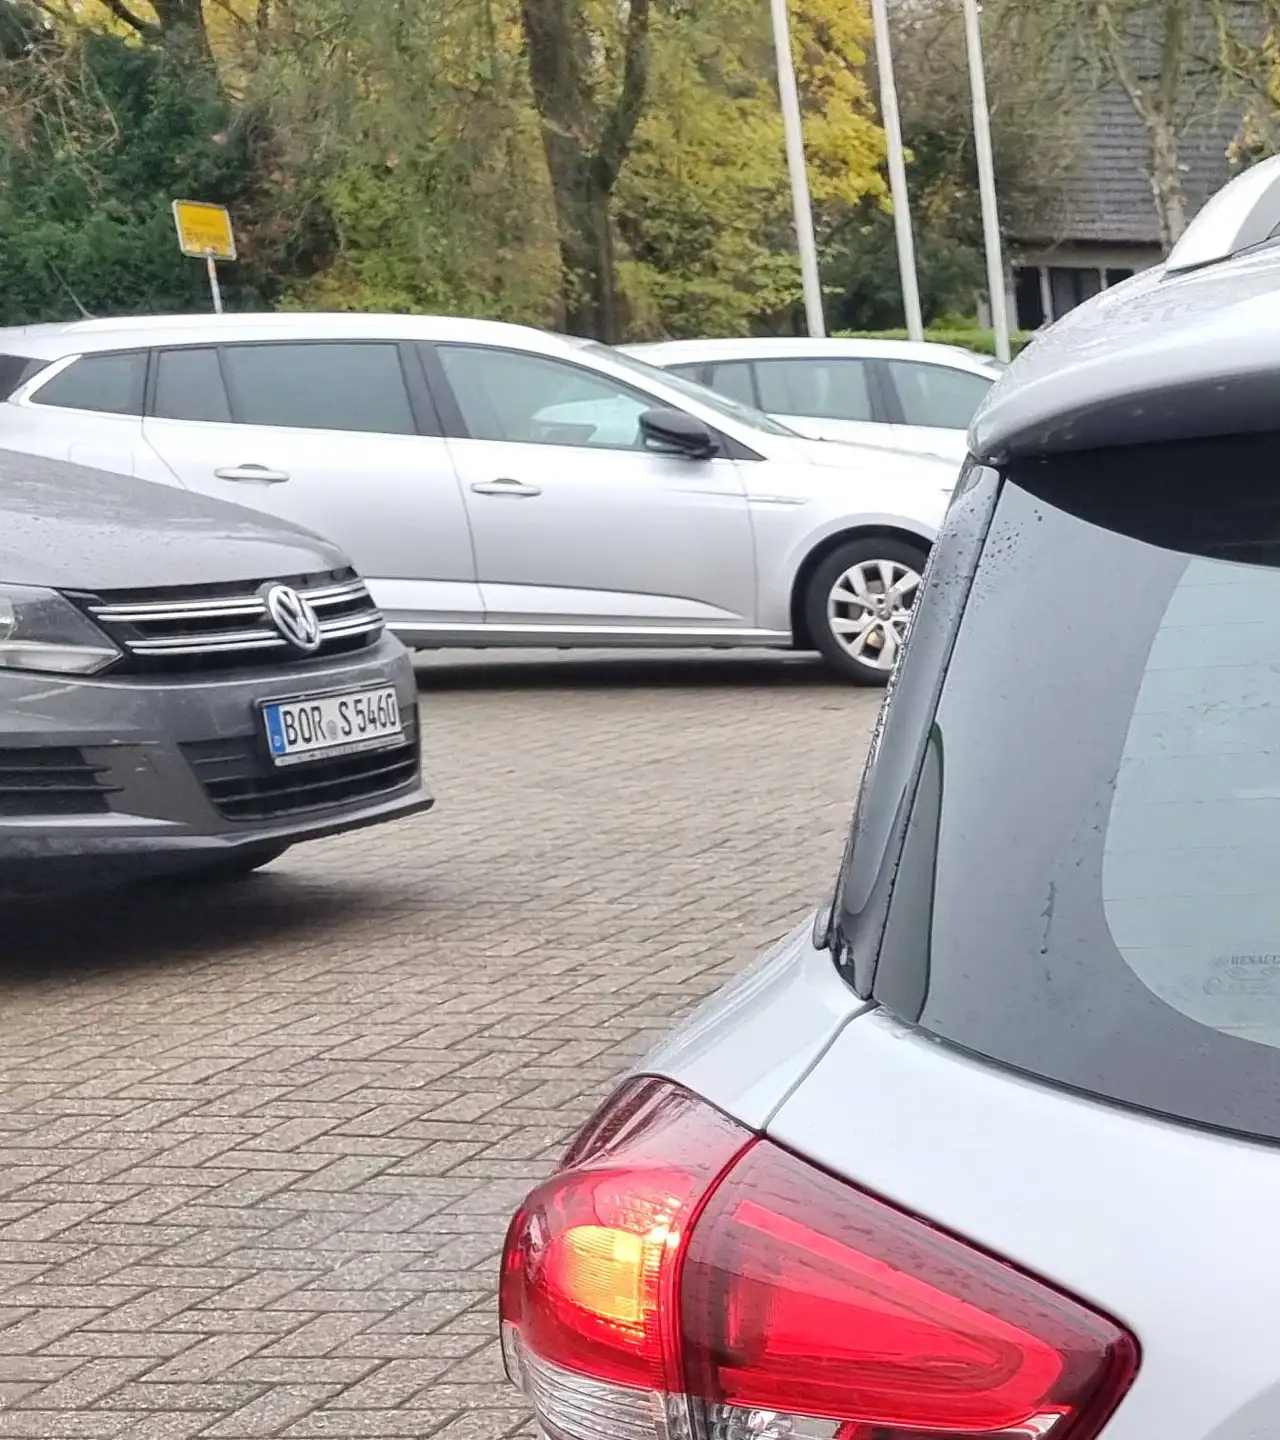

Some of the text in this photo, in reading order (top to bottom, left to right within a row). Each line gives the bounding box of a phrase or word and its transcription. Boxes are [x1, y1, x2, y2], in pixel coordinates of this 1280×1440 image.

[282, 692, 397, 746] BOR S 5460
